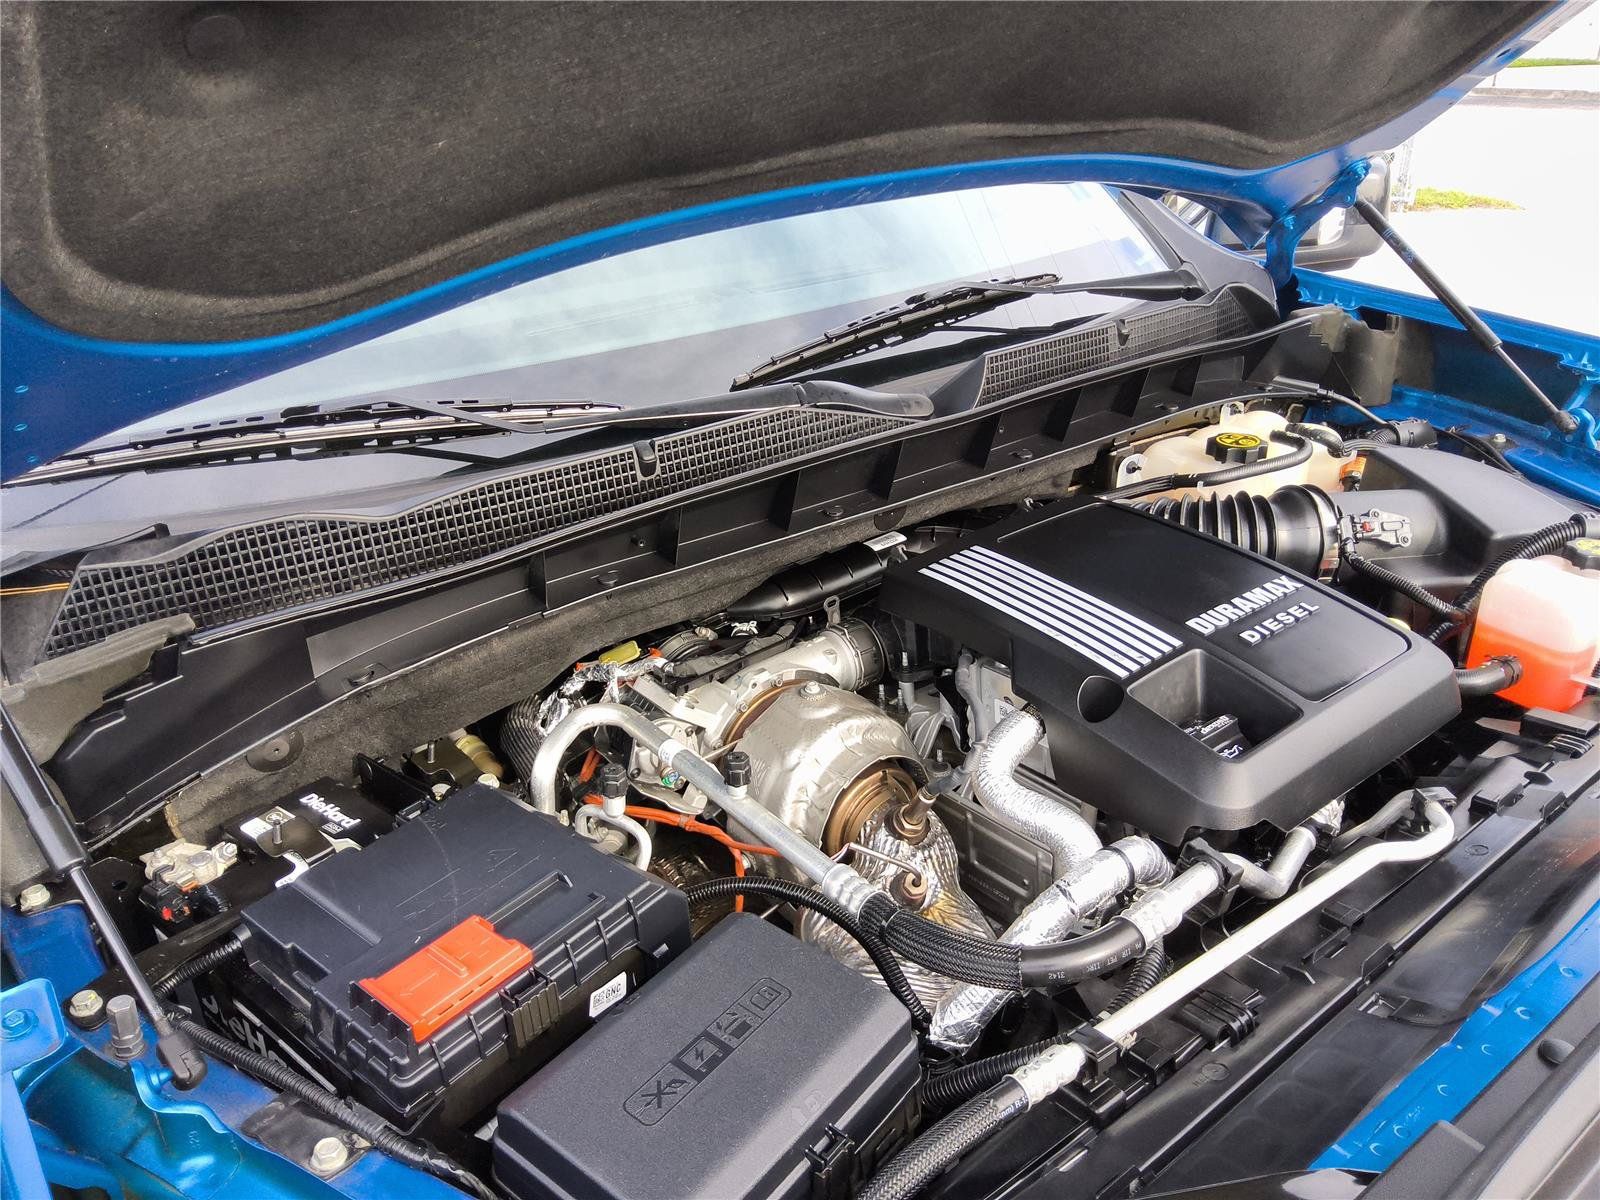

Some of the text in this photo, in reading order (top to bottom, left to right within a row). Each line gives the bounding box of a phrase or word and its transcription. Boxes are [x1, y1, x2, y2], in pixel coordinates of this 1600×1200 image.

[1185, 575, 1303, 636] DURAMAX
[1239, 602, 1320, 647] DIESEL
[299, 792, 362, 829] DieHard
